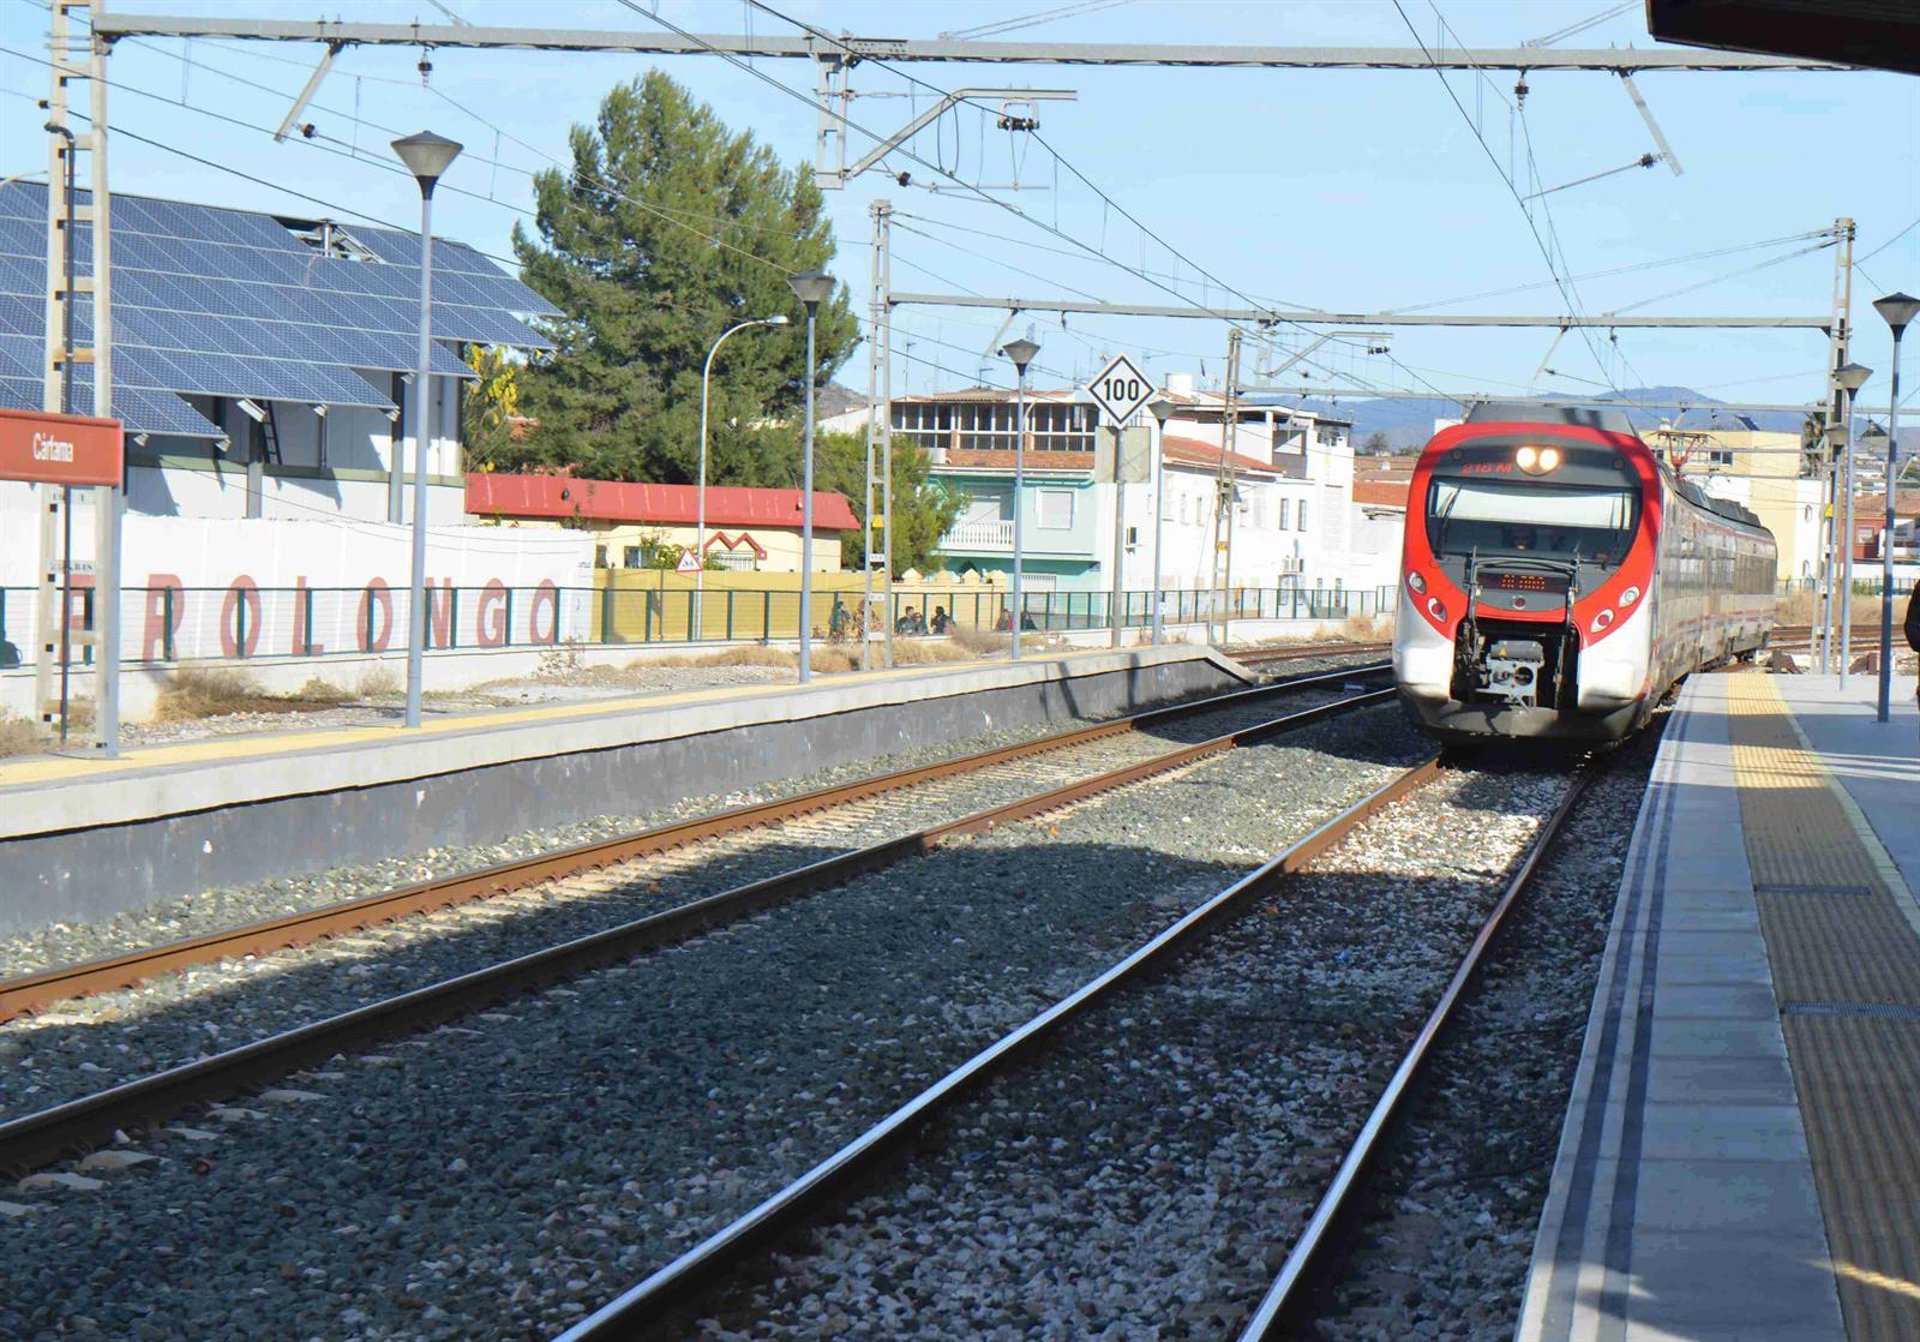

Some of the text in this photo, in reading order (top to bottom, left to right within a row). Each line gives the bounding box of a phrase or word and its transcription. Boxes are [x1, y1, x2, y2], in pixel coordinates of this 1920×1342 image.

[1104, 378, 1139, 401] 100
[33, 431, 73, 462] Cártama
[1496, 461, 1513, 473] M
